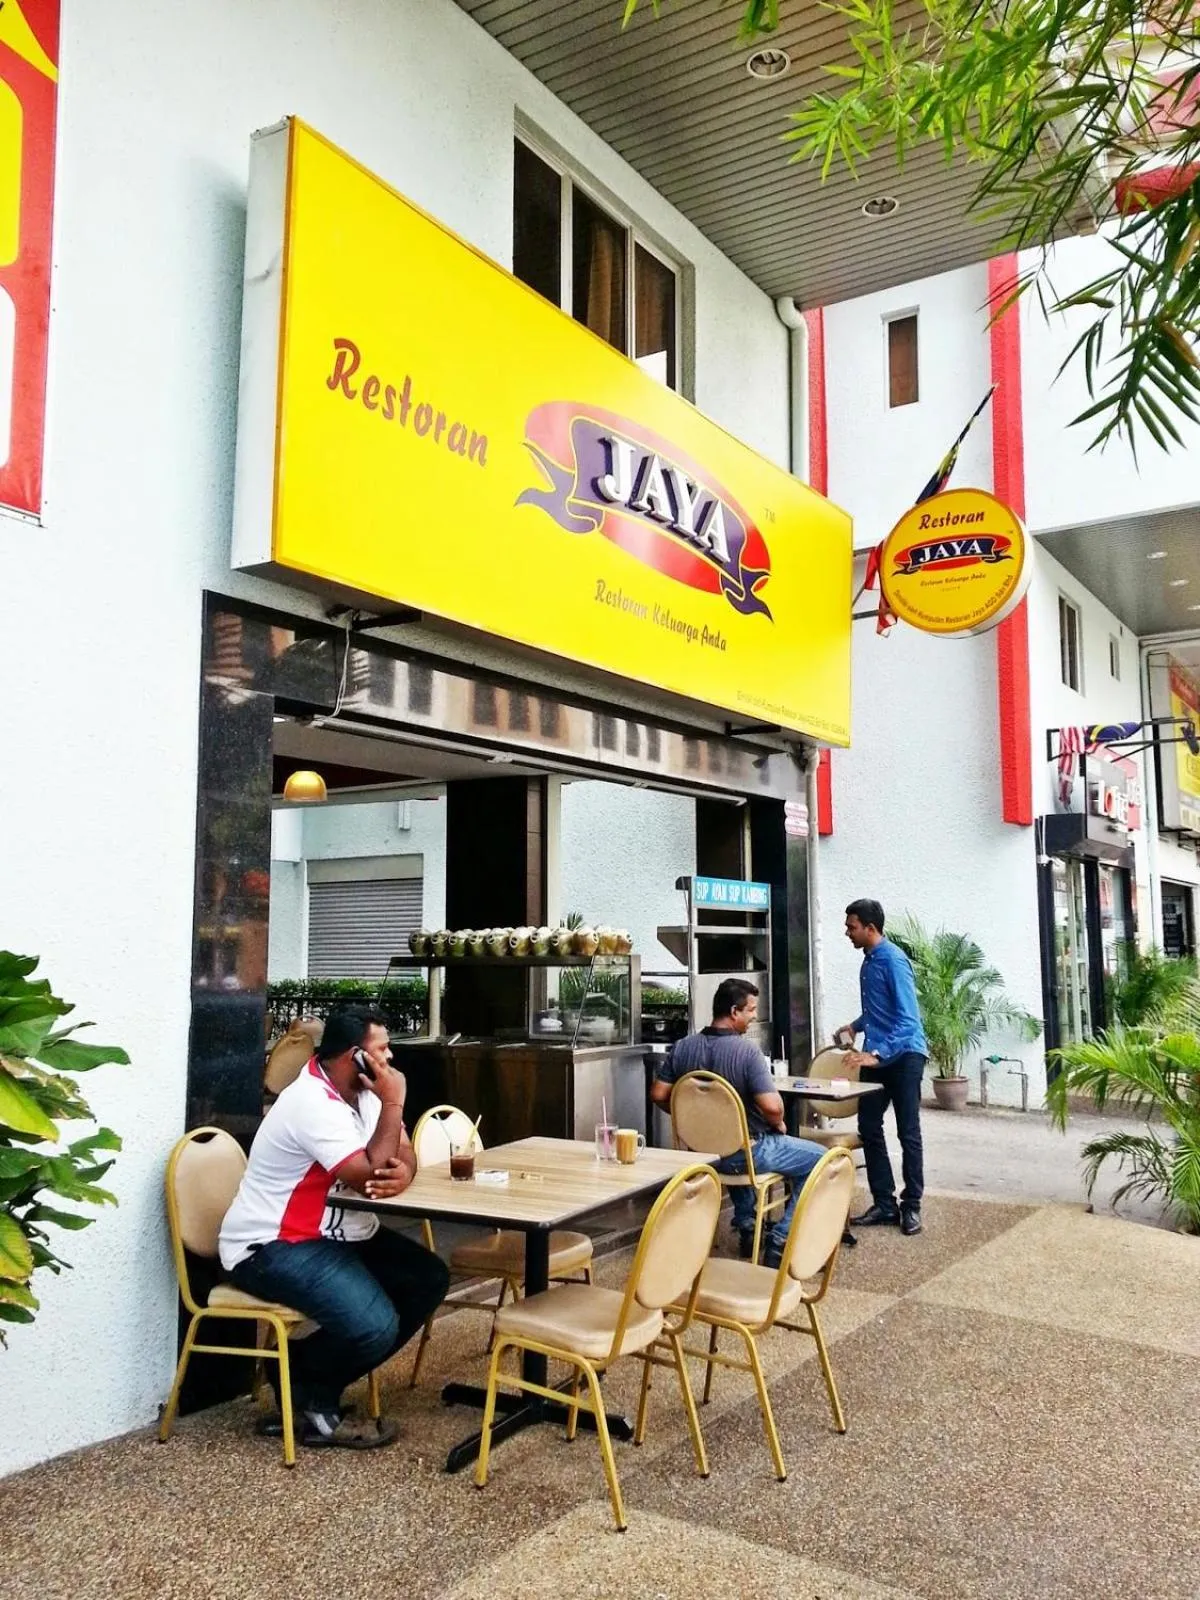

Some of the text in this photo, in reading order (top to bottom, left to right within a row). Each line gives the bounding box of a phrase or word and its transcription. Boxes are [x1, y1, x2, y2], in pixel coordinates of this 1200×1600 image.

[326, 337, 488, 468] Restoran
[592, 436, 731, 564] JAYA
[918, 511, 985, 530] Restoran
[919, 540, 982, 562] JAYA
[594, 579, 727, 652] Restoran Keluarga Anda
[696, 881, 709, 900] SUP
[728, 884, 741, 903] SUP
